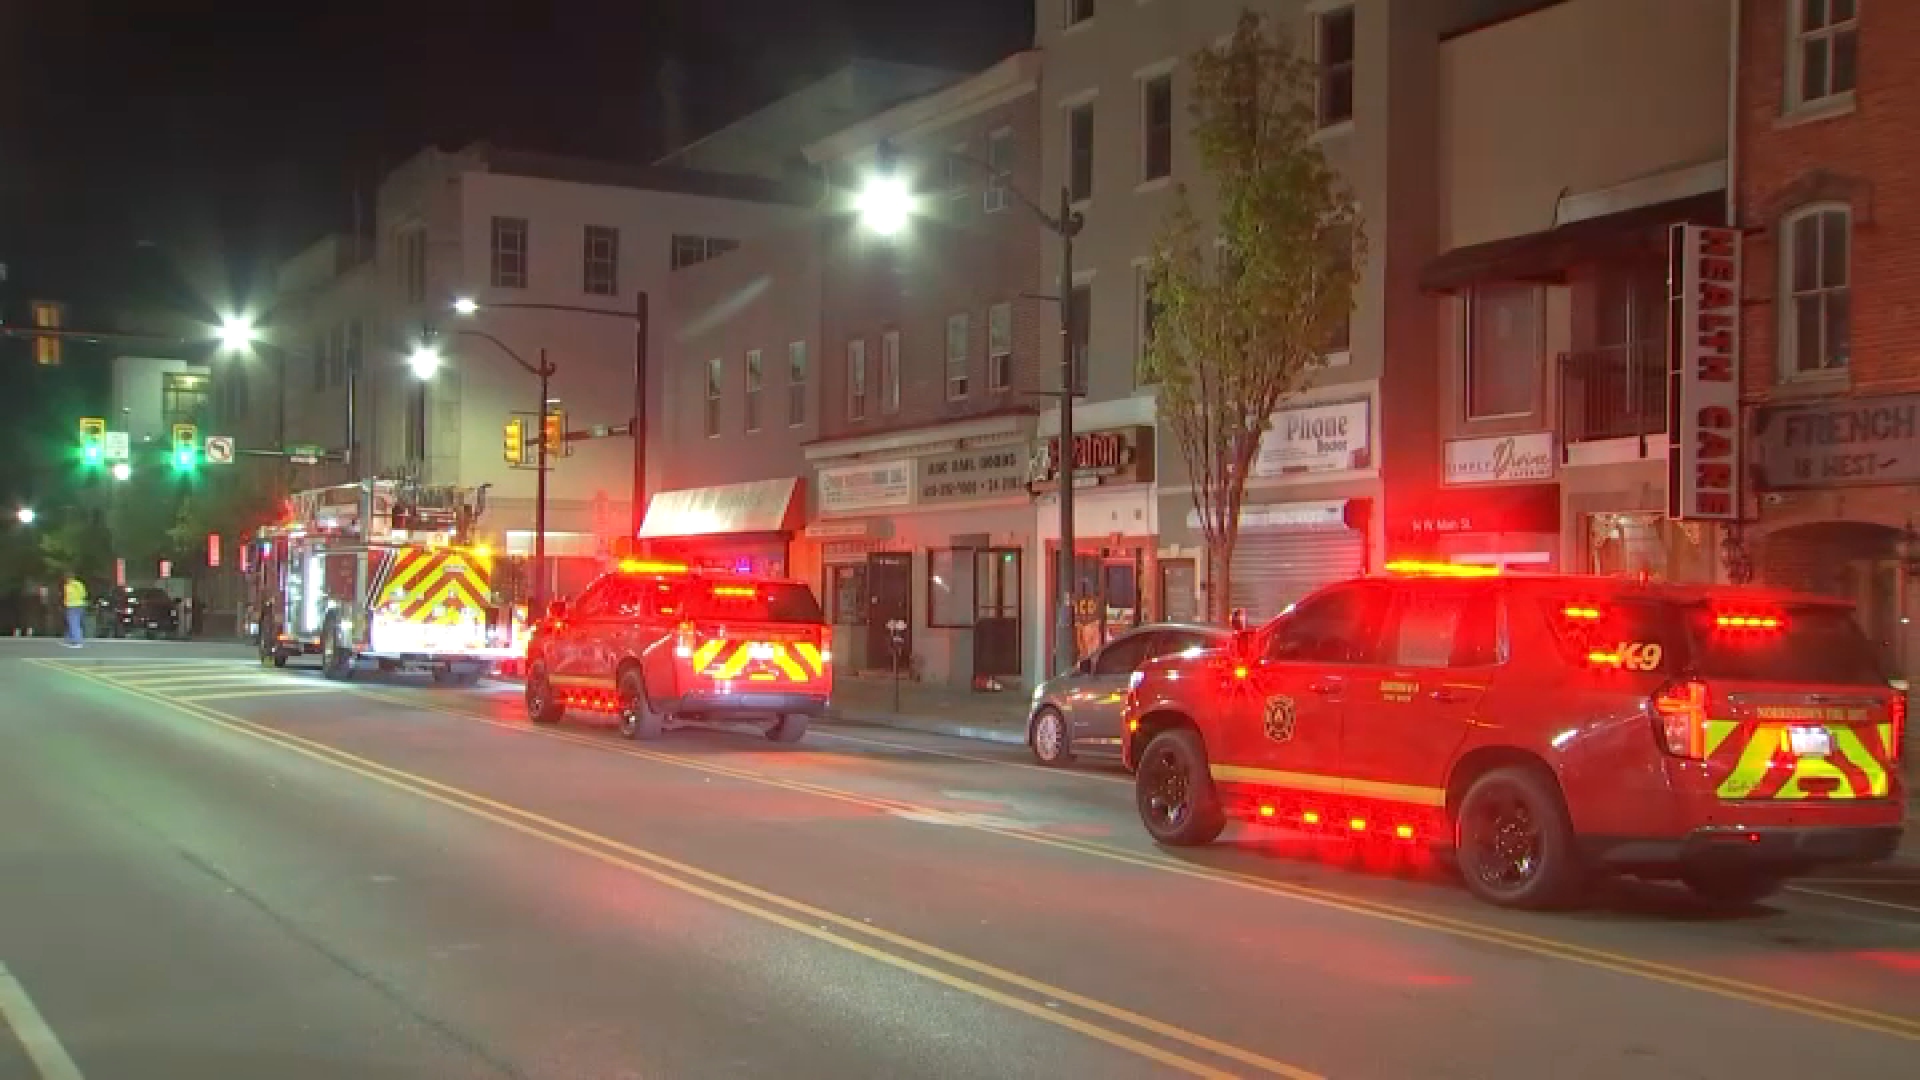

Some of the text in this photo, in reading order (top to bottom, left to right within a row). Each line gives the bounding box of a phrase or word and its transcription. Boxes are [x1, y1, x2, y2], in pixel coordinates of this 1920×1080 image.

[1696, 229, 1734, 514] HEALTH CARE
[1286, 411, 1348, 441] Phone
[1784, 406, 1916, 448] FRENCH
[952, 458, 976, 473] BAIL
[979, 452, 1017, 469] BONDS
[1446, 437, 1548, 479] SIMPLY Divine
[1821, 453, 1878, 477] WEST
[1613, 641, 1662, 671] K-9
